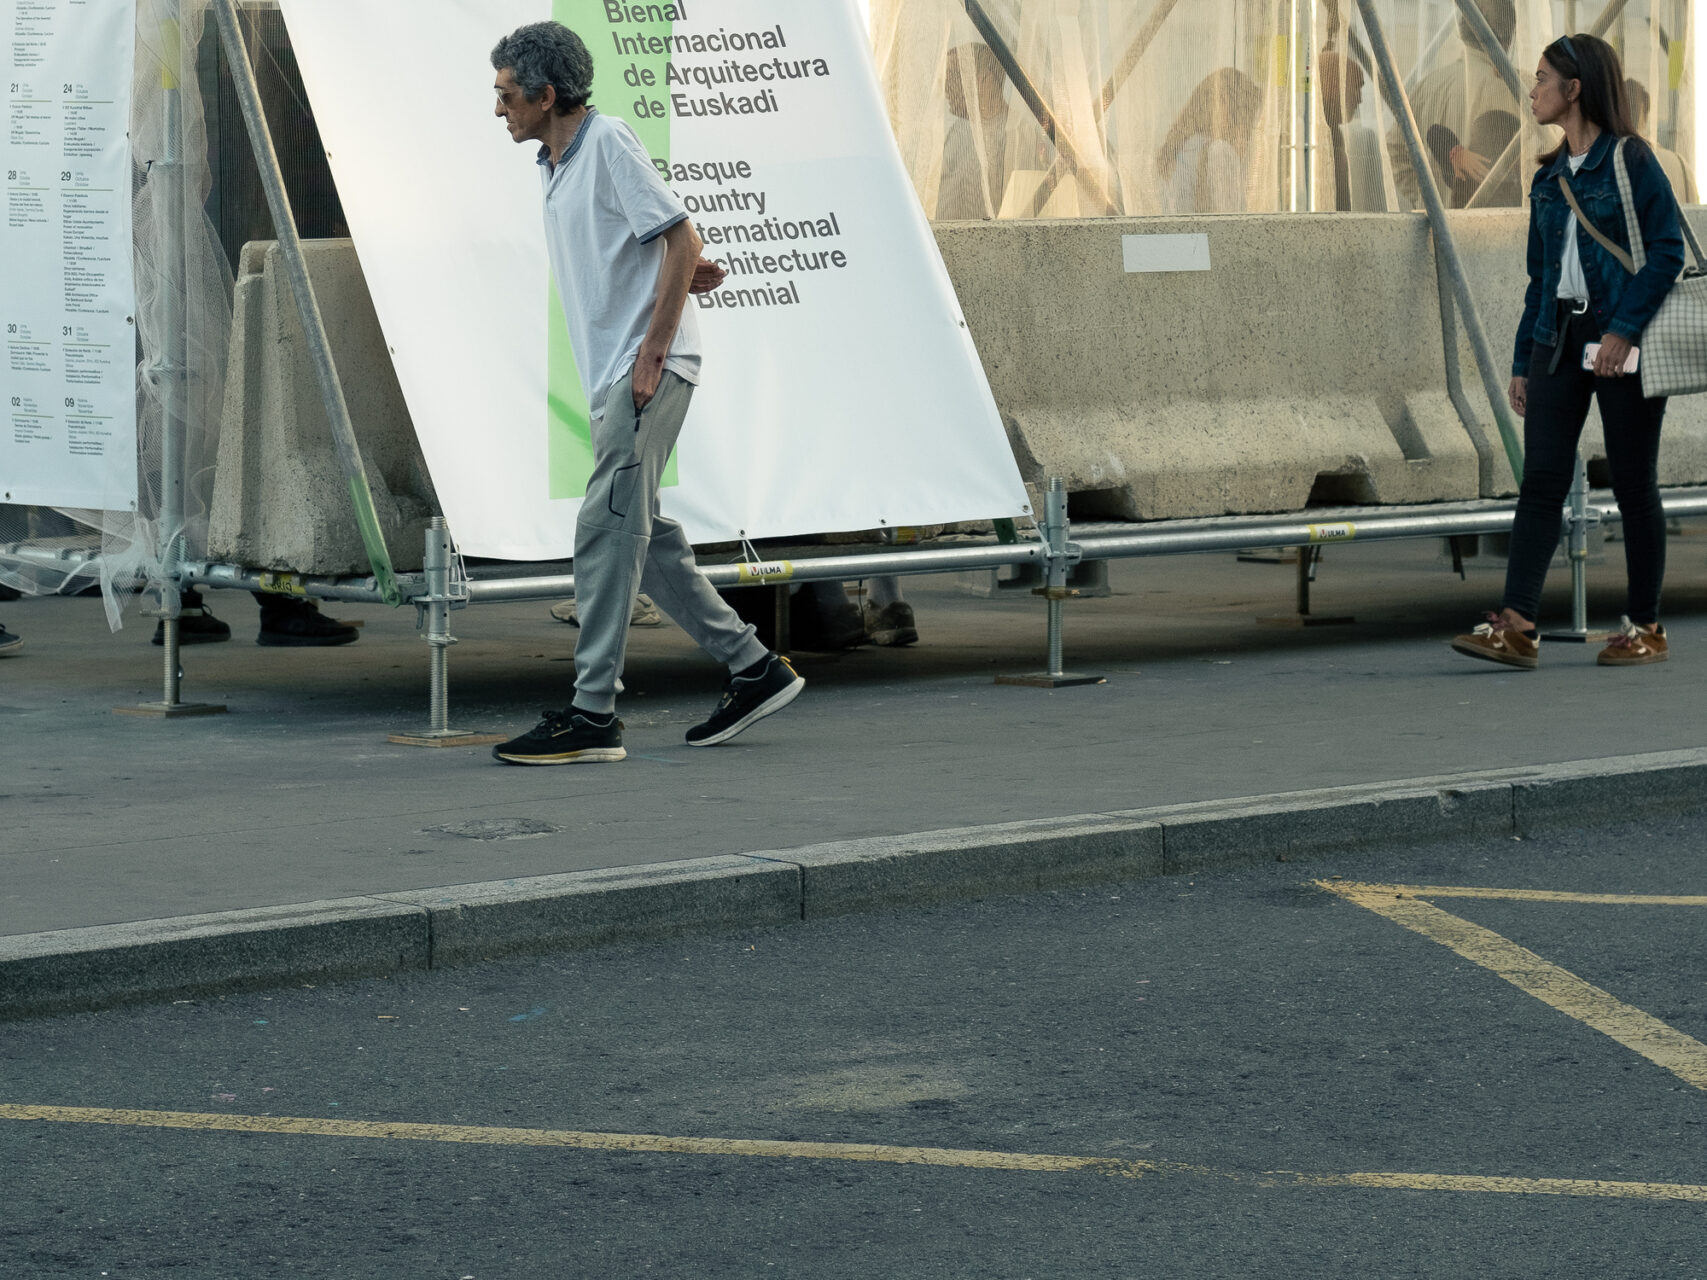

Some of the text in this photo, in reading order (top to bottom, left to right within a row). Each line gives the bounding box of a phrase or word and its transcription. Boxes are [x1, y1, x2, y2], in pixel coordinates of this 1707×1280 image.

[611, 25, 787, 56] Internacional
[623, 57, 830, 90] de Arquitectura
[10, 83, 19, 93] 21
[63, 83, 73, 94] 24
[632, 88, 779, 120] de Euskadi
[7, 170, 17, 180] 28
[61, 170, 71, 181] 29
[650, 158, 752, 185] Basque
[673, 188, 766, 215] ountry
[696, 211, 841, 245] ternational
[697, 280, 800, 309] Biennial
[7, 323, 17, 334] 30
[62, 326, 72, 336] 31
[11, 396, 21, 407] 02
[65, 397, 75, 408] 09
[1327, 529, 1346, 538] ULMA
[759, 566, 782, 575] ULMA
